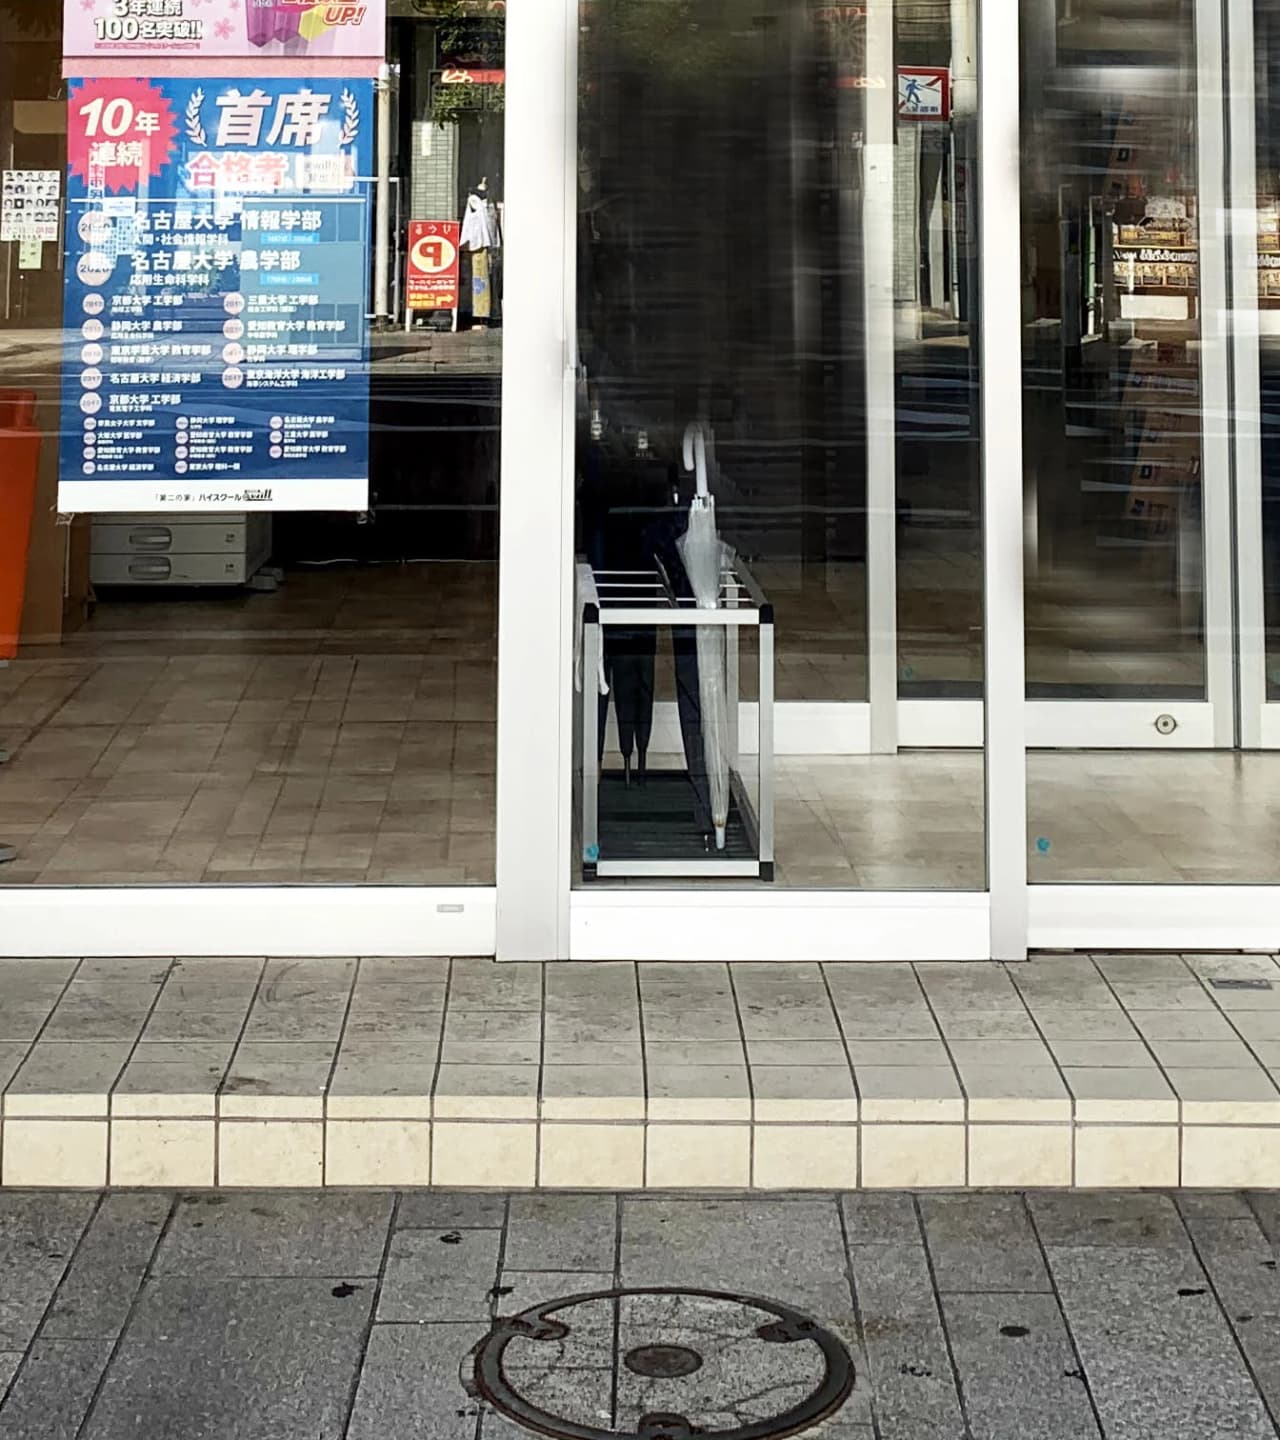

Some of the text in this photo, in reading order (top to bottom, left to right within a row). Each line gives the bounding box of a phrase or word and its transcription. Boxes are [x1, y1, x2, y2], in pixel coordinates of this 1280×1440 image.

[323, 6, 368, 26] UP!
[78, 97, 161, 138] 10年
[215, 88, 332, 148] 首席
[89, 140, 144, 168] 連続
[239, 209, 322, 231] 情報学部
[130, 249, 234, 271] 名古屋大学
